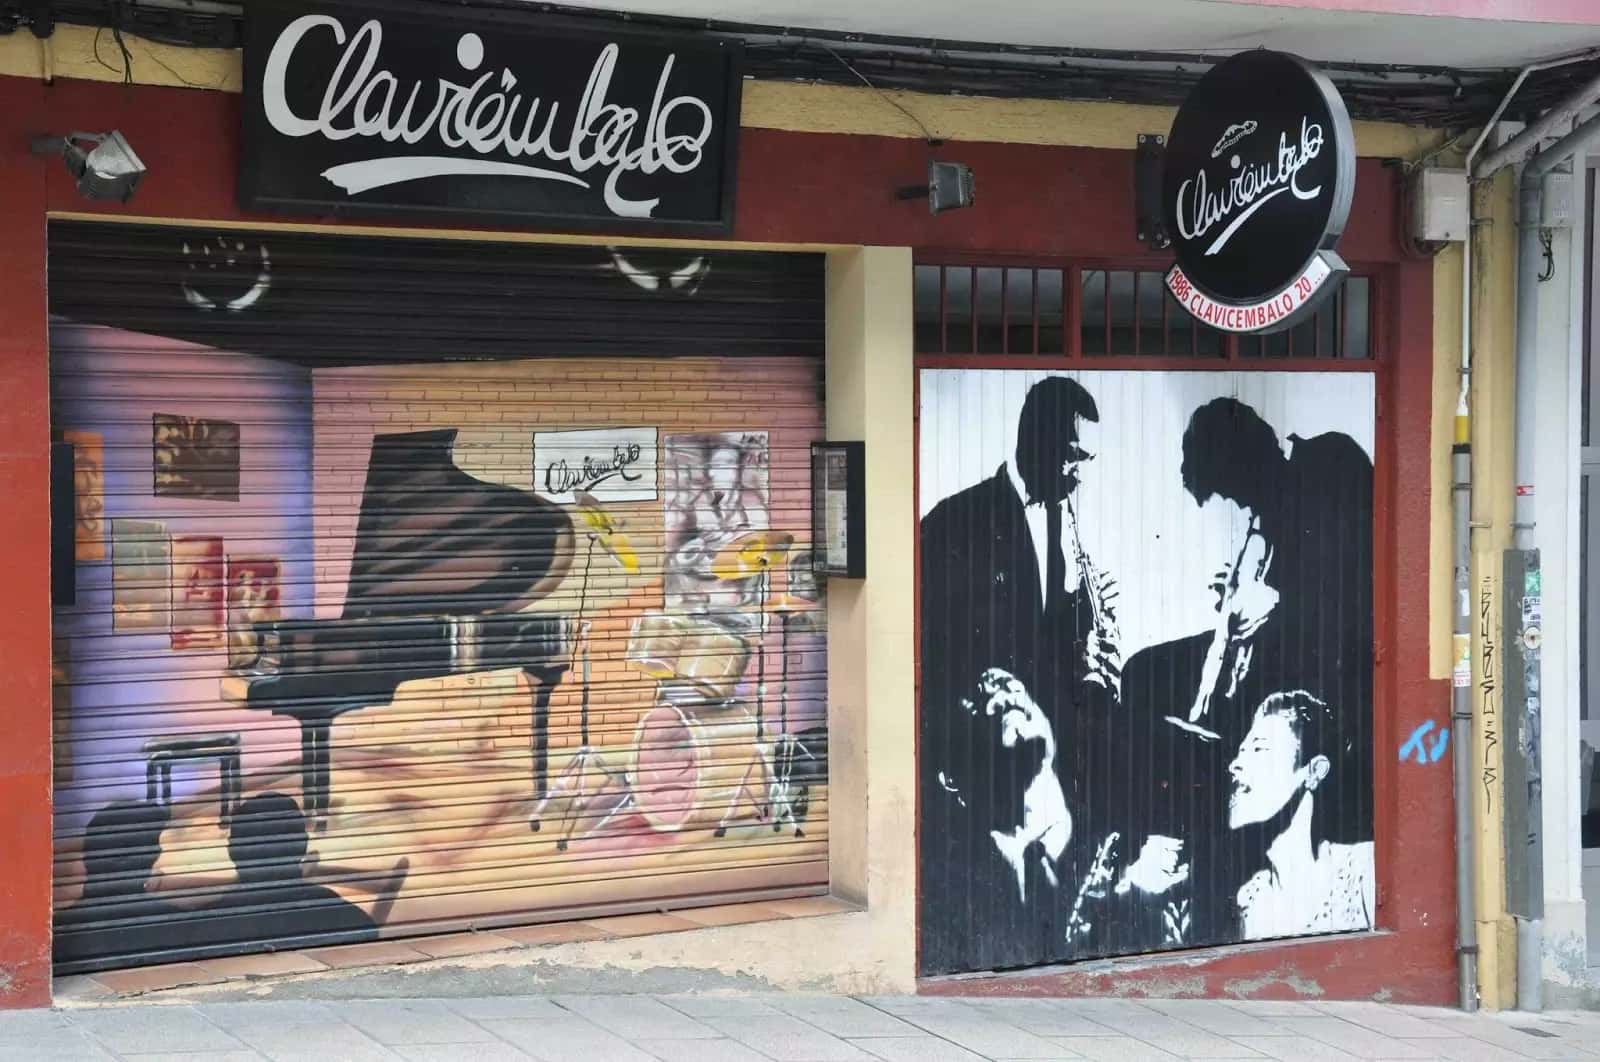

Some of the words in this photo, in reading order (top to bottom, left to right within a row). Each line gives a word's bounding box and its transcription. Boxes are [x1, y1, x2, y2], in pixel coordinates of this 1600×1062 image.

[1168, 270, 1192, 302] 1986
[1190, 293, 1294, 329] CLAVICEMBALO
[1294, 276, 1312, 301] 20
